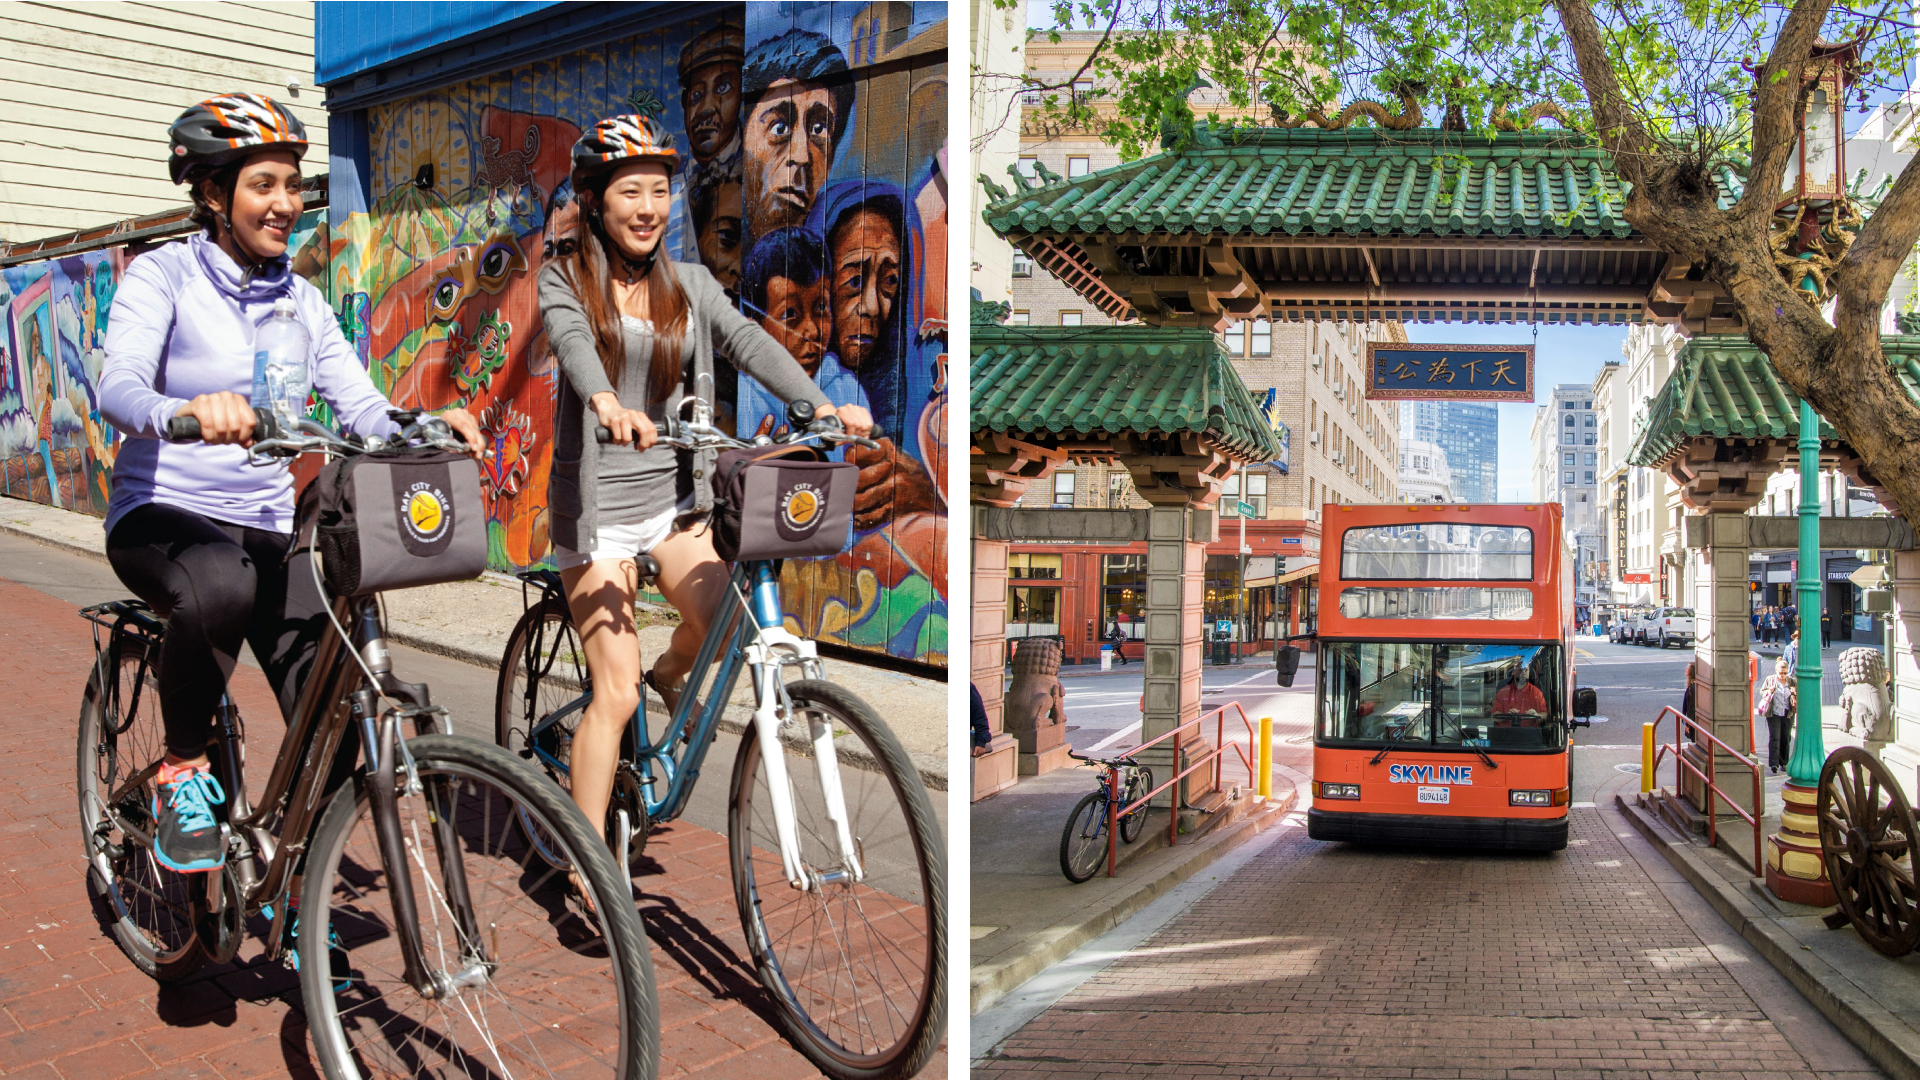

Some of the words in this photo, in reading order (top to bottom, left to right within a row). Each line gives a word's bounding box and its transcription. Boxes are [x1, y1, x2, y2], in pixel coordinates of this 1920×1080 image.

[1390, 357, 1517, 386] 天下為公
[401, 491, 411, 512] BAY
[411, 482, 431, 491] CITY
[434, 488, 450, 511] BIKE
[781, 490, 793, 507] BAY
[794, 483, 813, 491] CITY
[813, 488, 826, 506] BIKE
[1240, 504, 1252, 516] Grant
[1619, 490, 1627, 578] FARINELLI
[1389, 763, 1473, 786] SKYLINE
